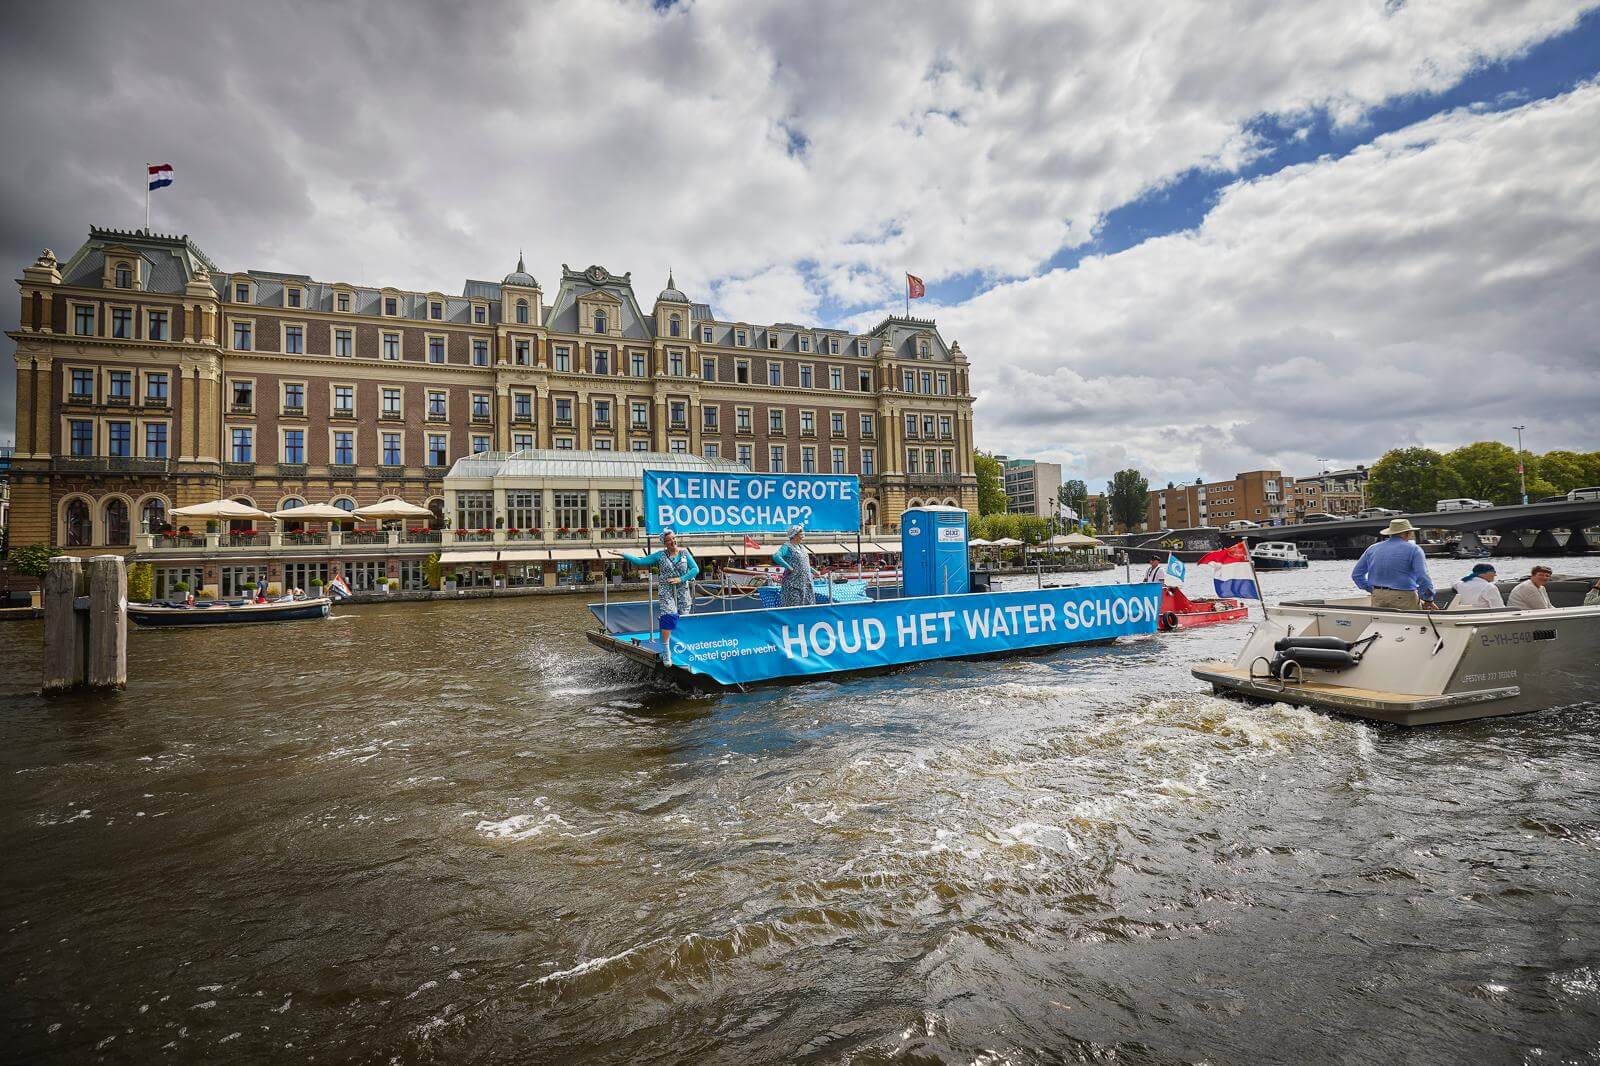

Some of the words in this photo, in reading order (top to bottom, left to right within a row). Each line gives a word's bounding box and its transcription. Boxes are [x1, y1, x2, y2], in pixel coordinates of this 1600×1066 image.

[657, 477, 740, 499] KLEINE
[747, 479, 776, 500] OF
[782, 480, 852, 500] GROTE
[658, 505, 812, 526] BOODSCHAP?
[781, 617, 886, 659] HOUD
[897, 610, 956, 648] HET
[963, 603, 1057, 640] WATER
[1063, 596, 1160, 630] SCHOON
[687, 638, 738, 650] waterschap
[688, 650, 719, 662] amstel
[720, 648, 740, 661] gooi
[740, 646, 752, 656] en
[753, 644, 777, 654] vecht
